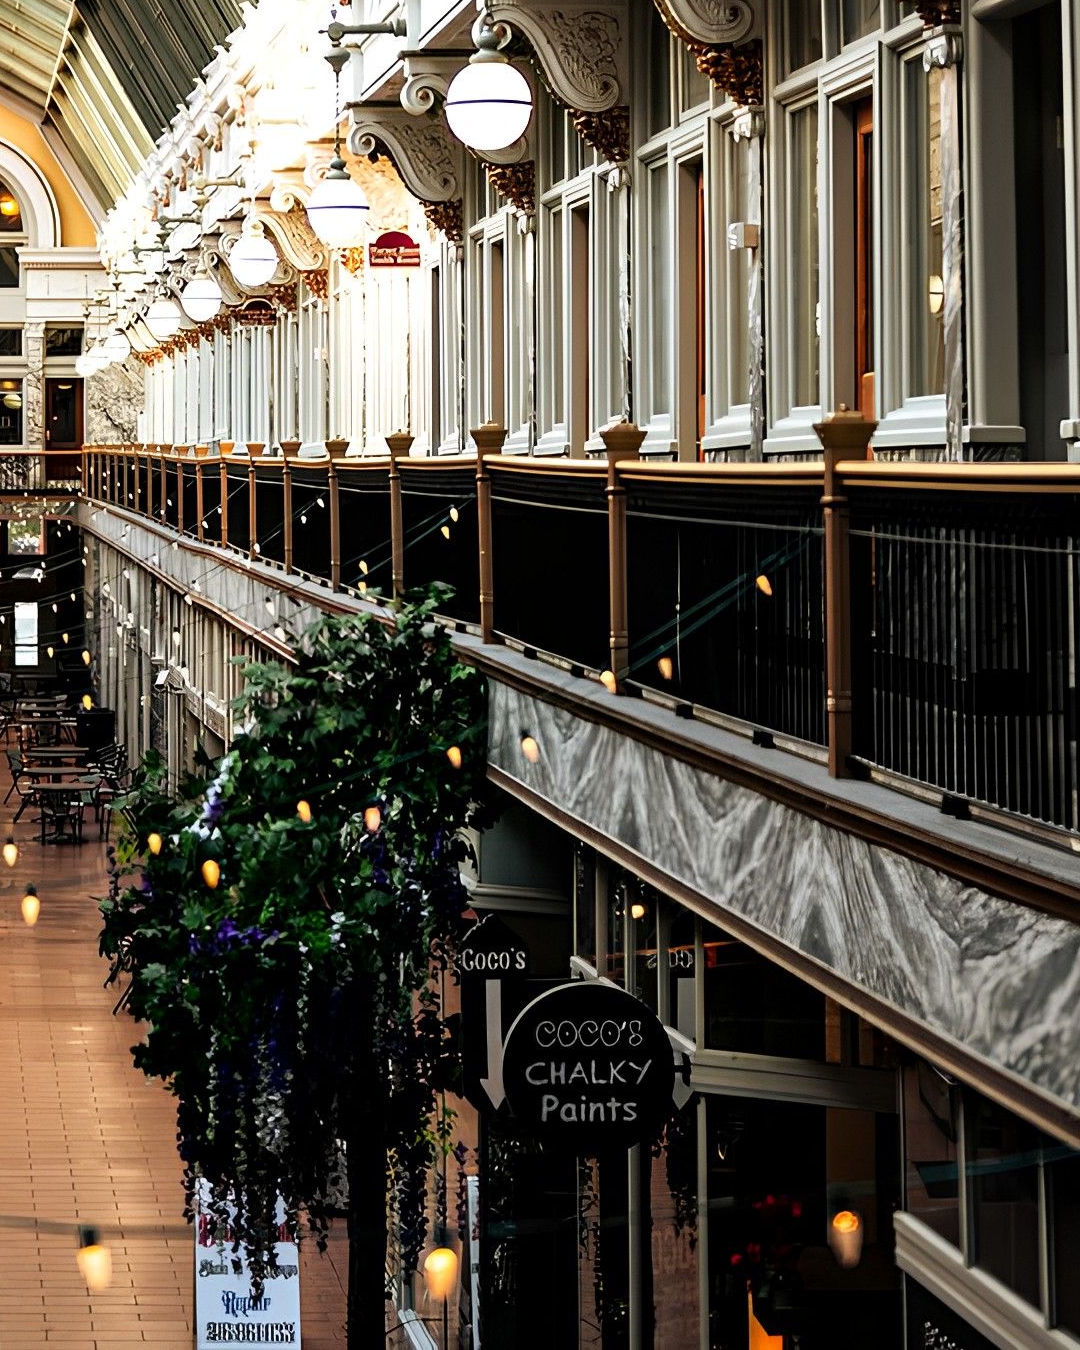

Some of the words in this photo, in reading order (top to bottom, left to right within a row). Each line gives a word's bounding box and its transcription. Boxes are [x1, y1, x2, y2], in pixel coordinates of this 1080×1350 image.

[461, 948, 526, 971] Coco's
[535, 1020, 643, 1047] COCO'S
[525, 1059, 652, 1085] CHALKY
[541, 1094, 637, 1122] Paints
